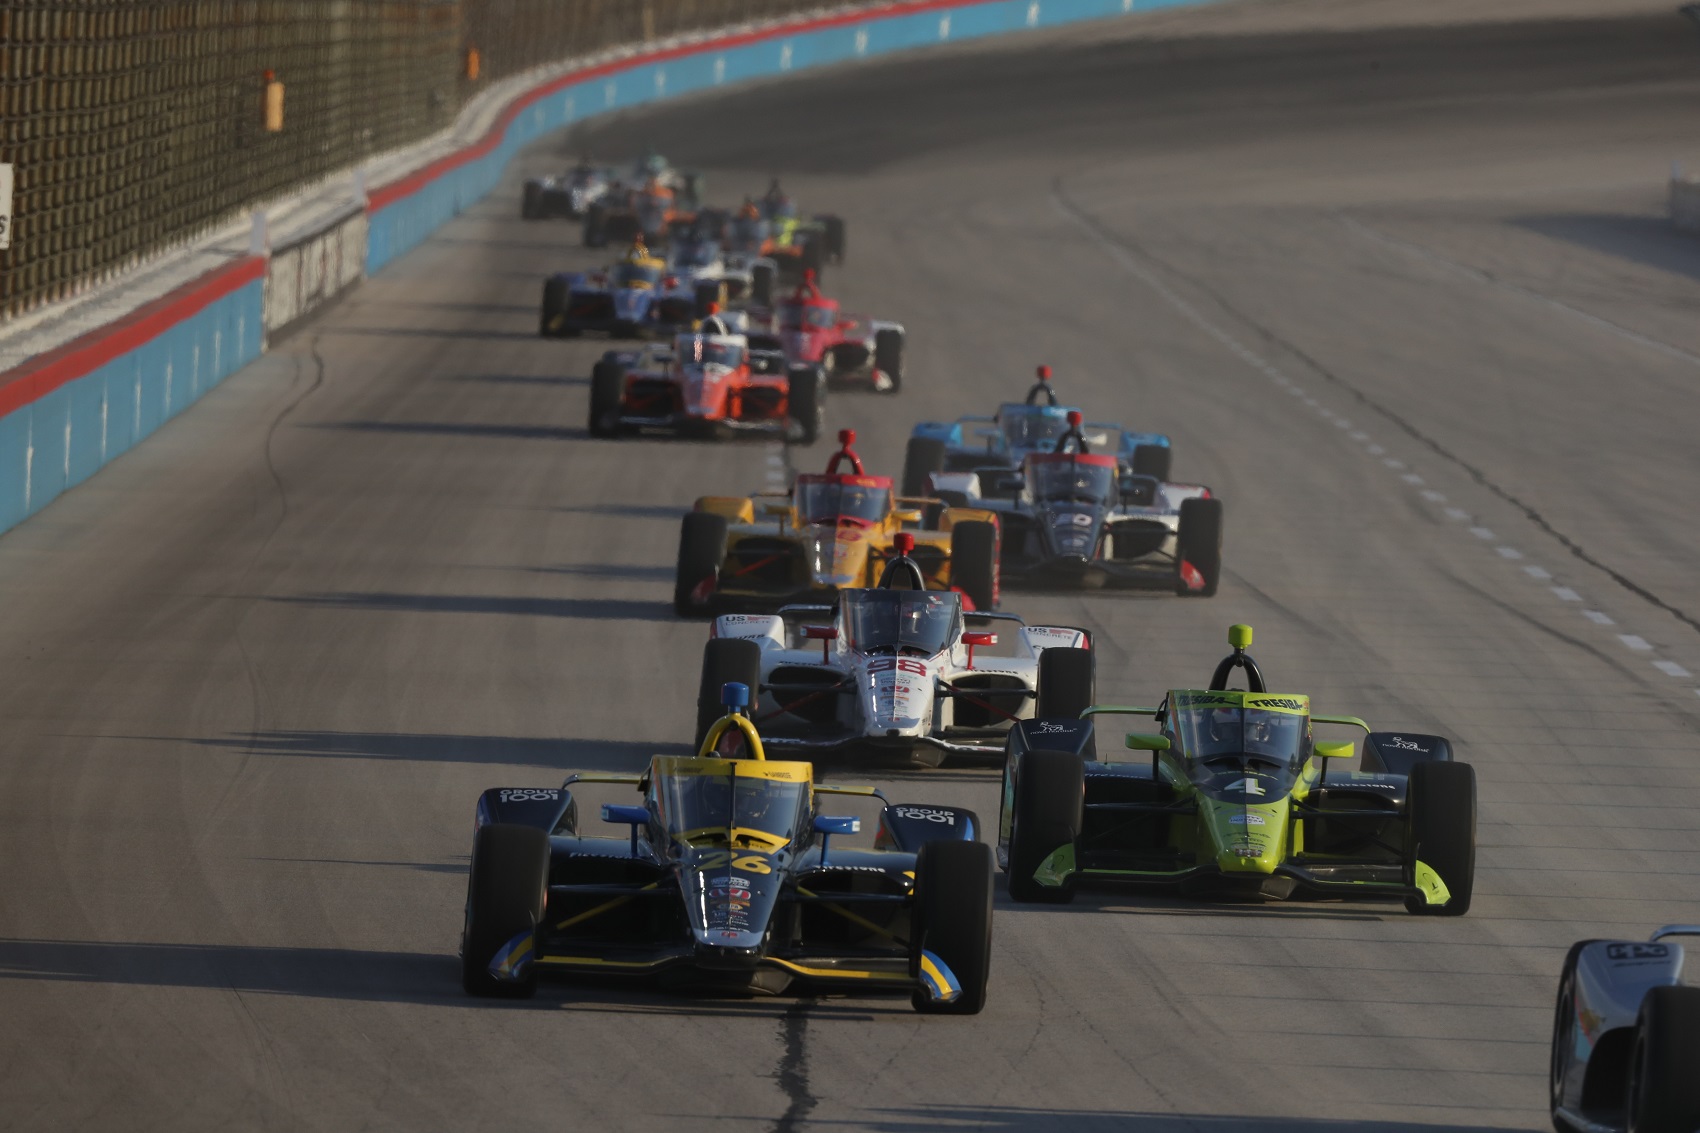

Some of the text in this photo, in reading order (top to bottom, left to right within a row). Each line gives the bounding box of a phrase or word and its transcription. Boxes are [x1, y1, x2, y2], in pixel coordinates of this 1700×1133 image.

[866, 659, 927, 677] 98
[1248, 698, 1303, 711] TRESIBA
[1223, 777, 1267, 797] 4
[500, 793, 560, 803] 1001
[896, 806, 955, 817] GROUP
[896, 809, 955, 826] 1001
[694, 851, 772, 875] 26
